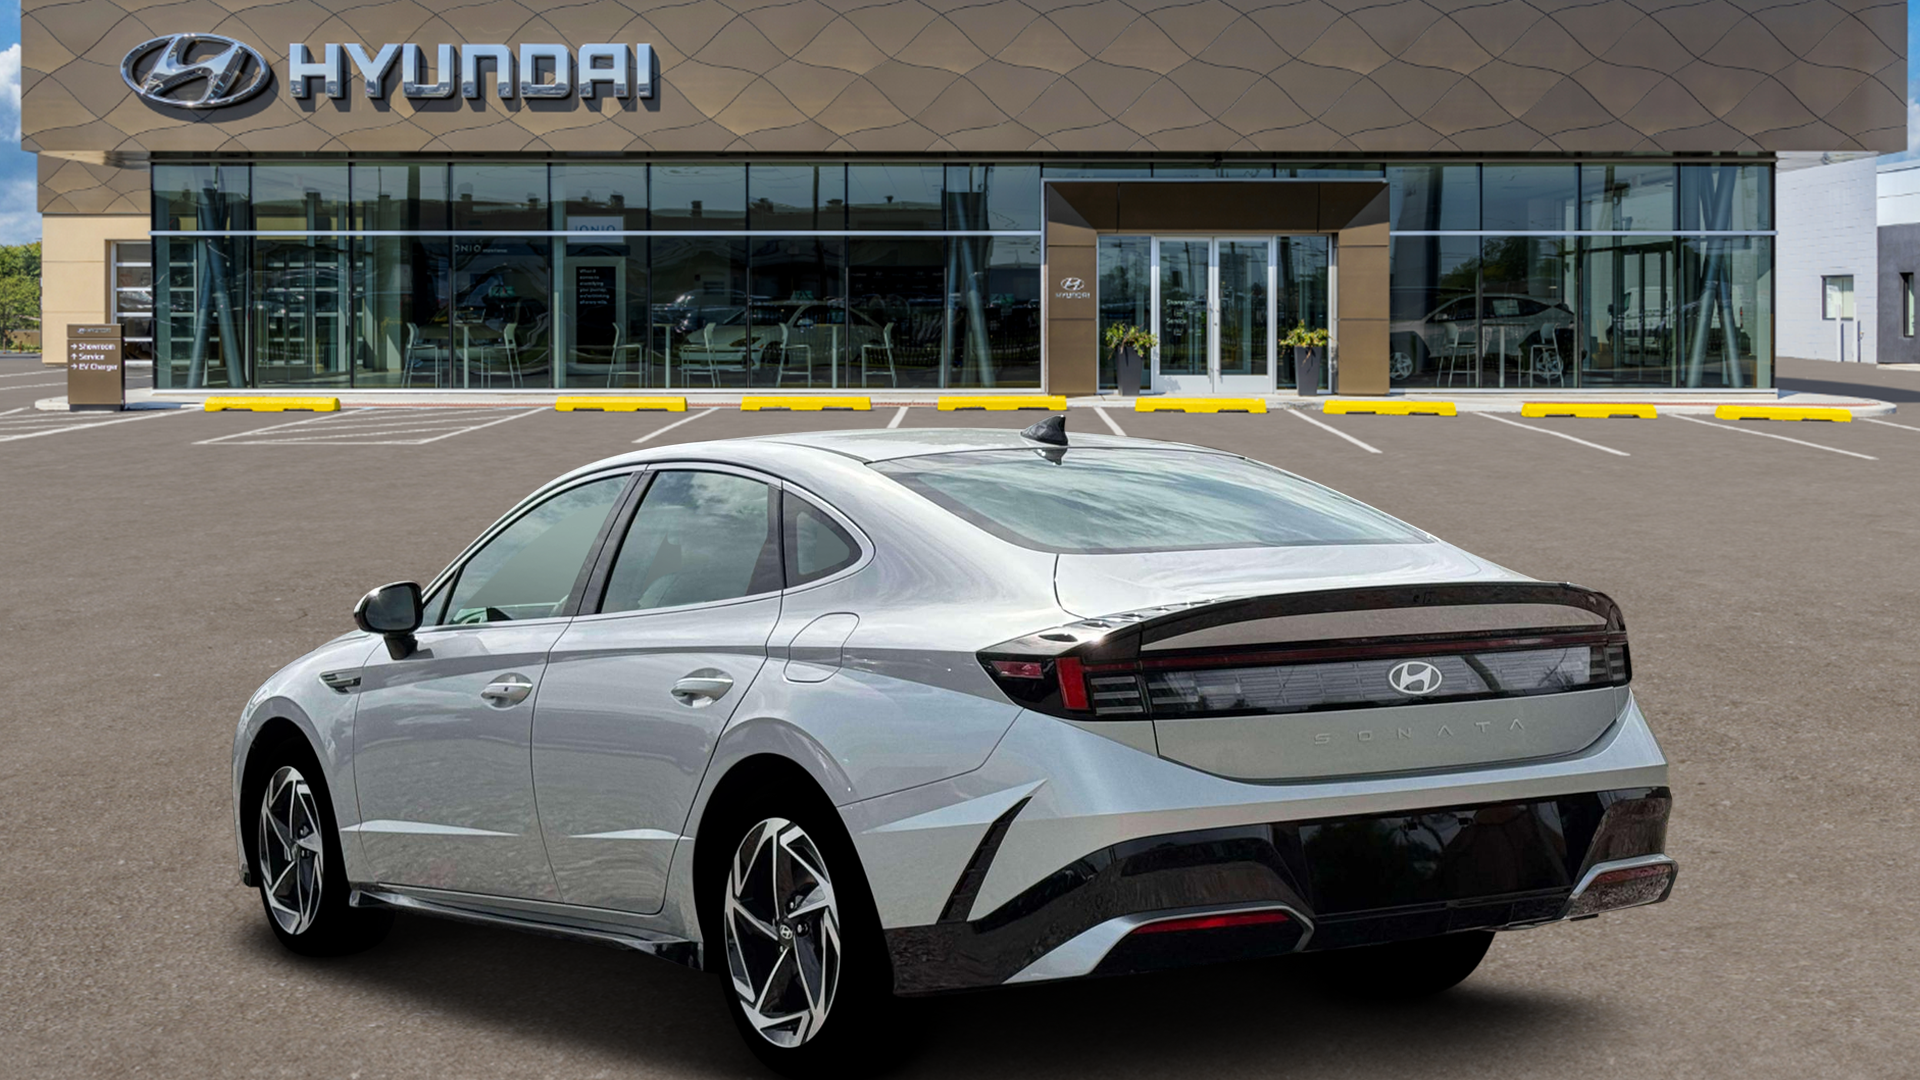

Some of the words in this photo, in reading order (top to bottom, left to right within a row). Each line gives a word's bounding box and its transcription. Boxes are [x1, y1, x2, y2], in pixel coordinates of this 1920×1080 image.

[289, 43, 655, 100] HYUNDAI
[78, 343, 116, 351] Showroom
[78, 352, 105, 361] Service
[90, 363, 118, 372] Charger
[1314, 718, 1524, 745] SONATA
